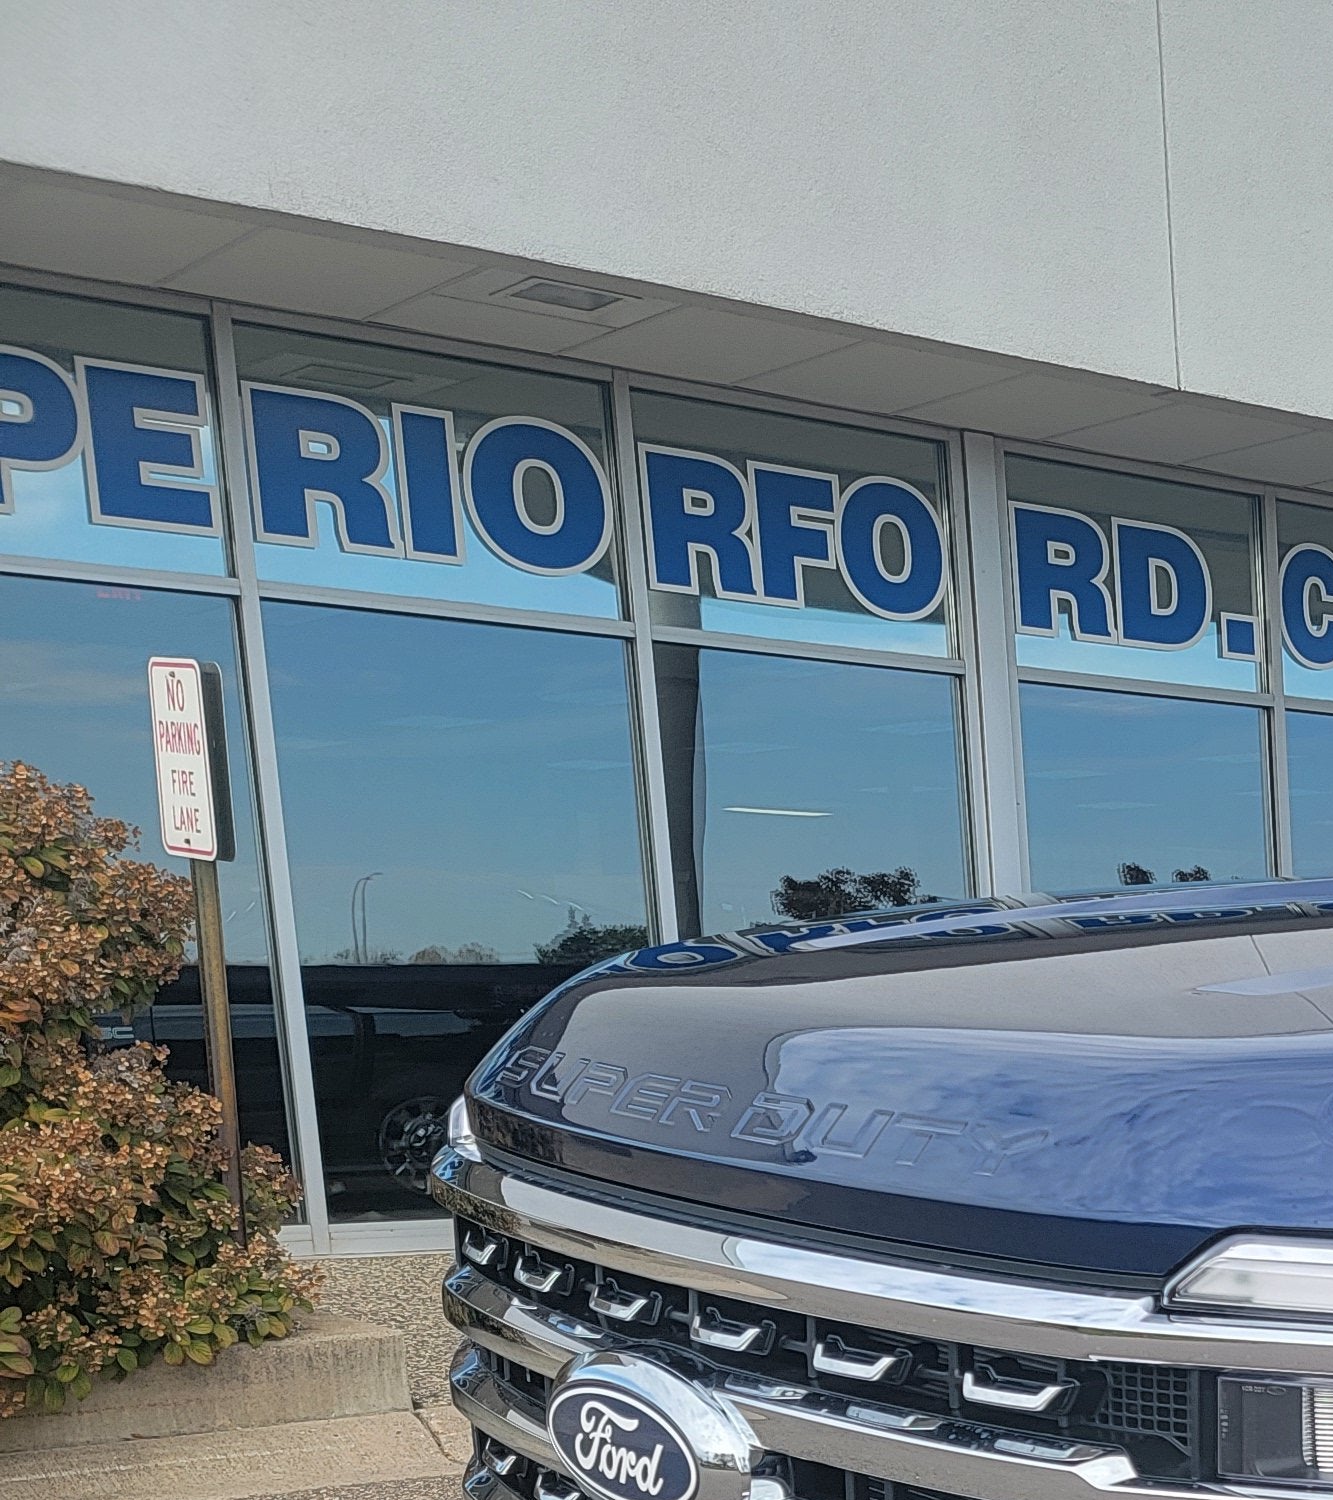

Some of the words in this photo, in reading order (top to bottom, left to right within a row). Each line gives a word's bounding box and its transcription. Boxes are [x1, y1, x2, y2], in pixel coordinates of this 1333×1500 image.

[165, 678, 185, 712] NO
[158, 720, 201, 756] PARKING
[170, 769, 196, 797] FIRE
[172, 805, 202, 834] LANE
[499, 1045, 732, 1132] SUPER
[730, 1090, 1050, 1178] DUTY
[574, 1400, 664, 1496] Ford
